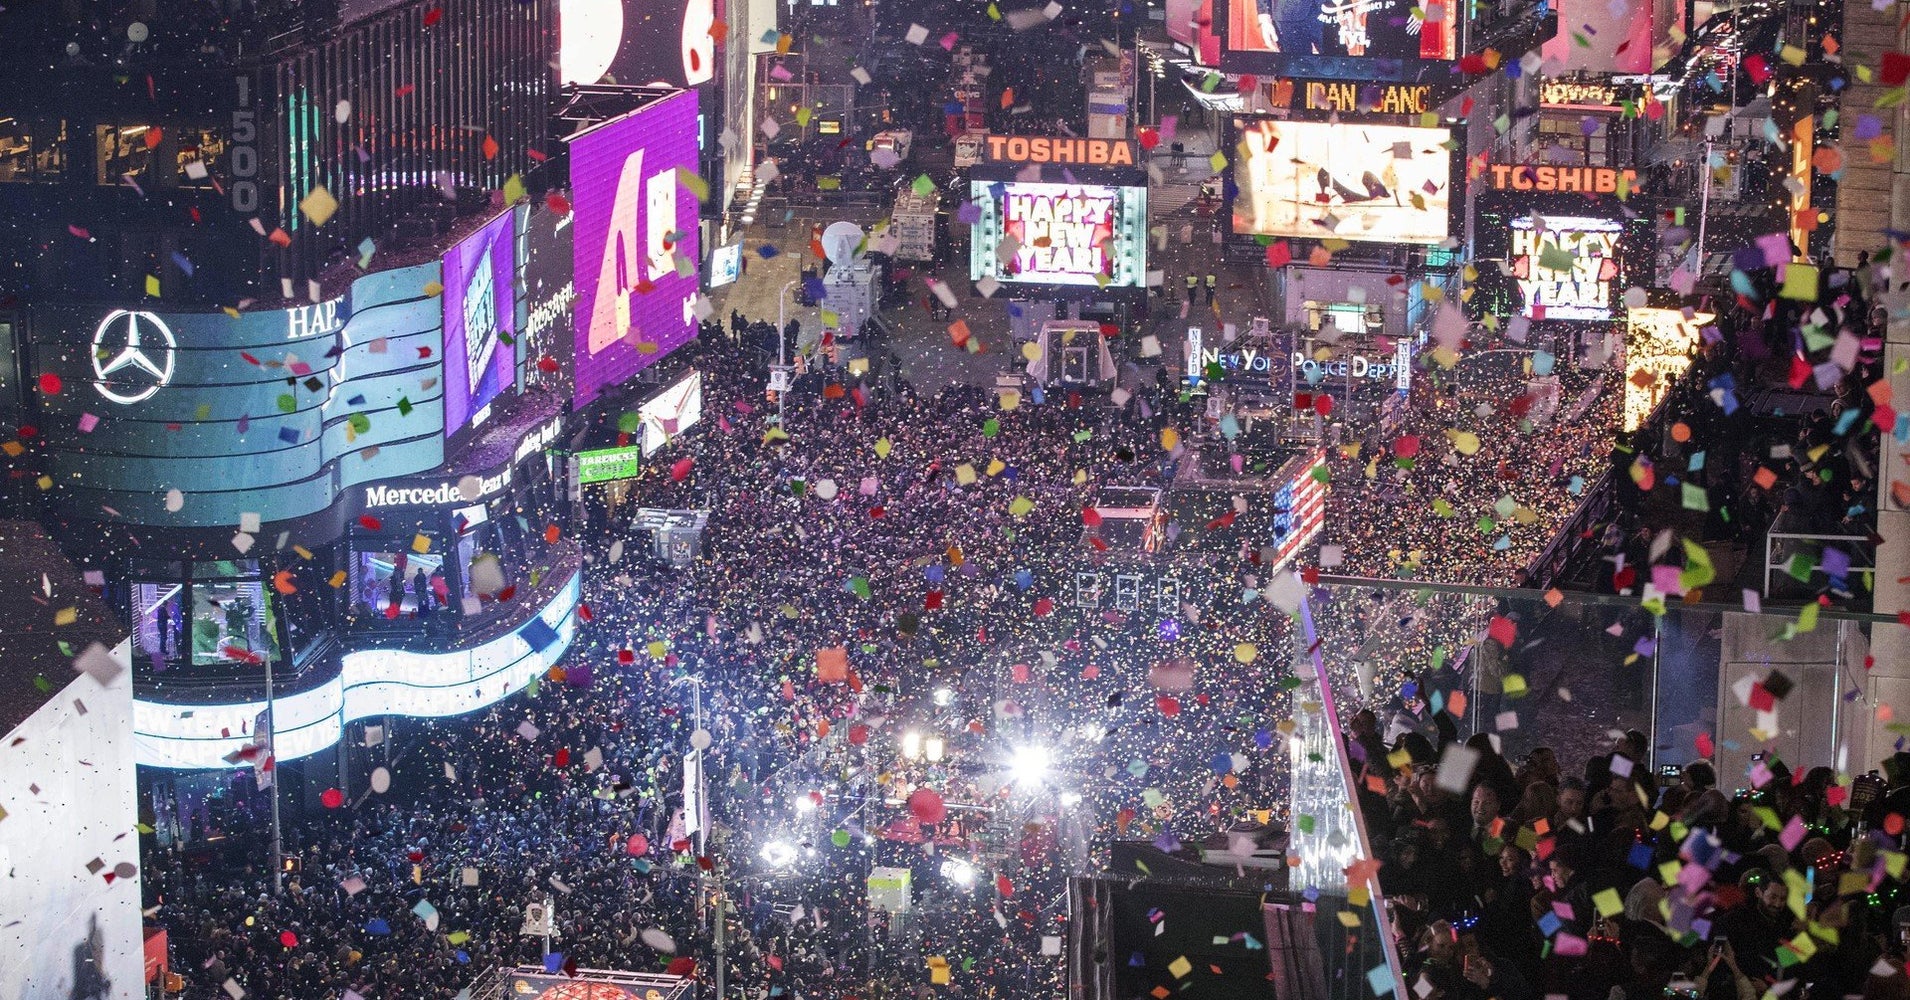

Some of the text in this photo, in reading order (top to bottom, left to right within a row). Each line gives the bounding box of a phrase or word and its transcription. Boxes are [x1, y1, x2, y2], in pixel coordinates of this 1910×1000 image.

[1306, 82, 1356, 111] IRAN
[1371, 84, 1431, 114] ANC
[232, 76, 258, 212] 1500
[988, 136, 1133, 165] TOSHIBA
[1009, 194, 1112, 222] HAPPY
[1024, 221, 1096, 248] NEW
[1513, 230, 1621, 258] HAPPY
[1018, 247, 1102, 274] YEAR!
[1517, 281, 1609, 308] YEAR!
[287, 295, 345, 339] HAP
